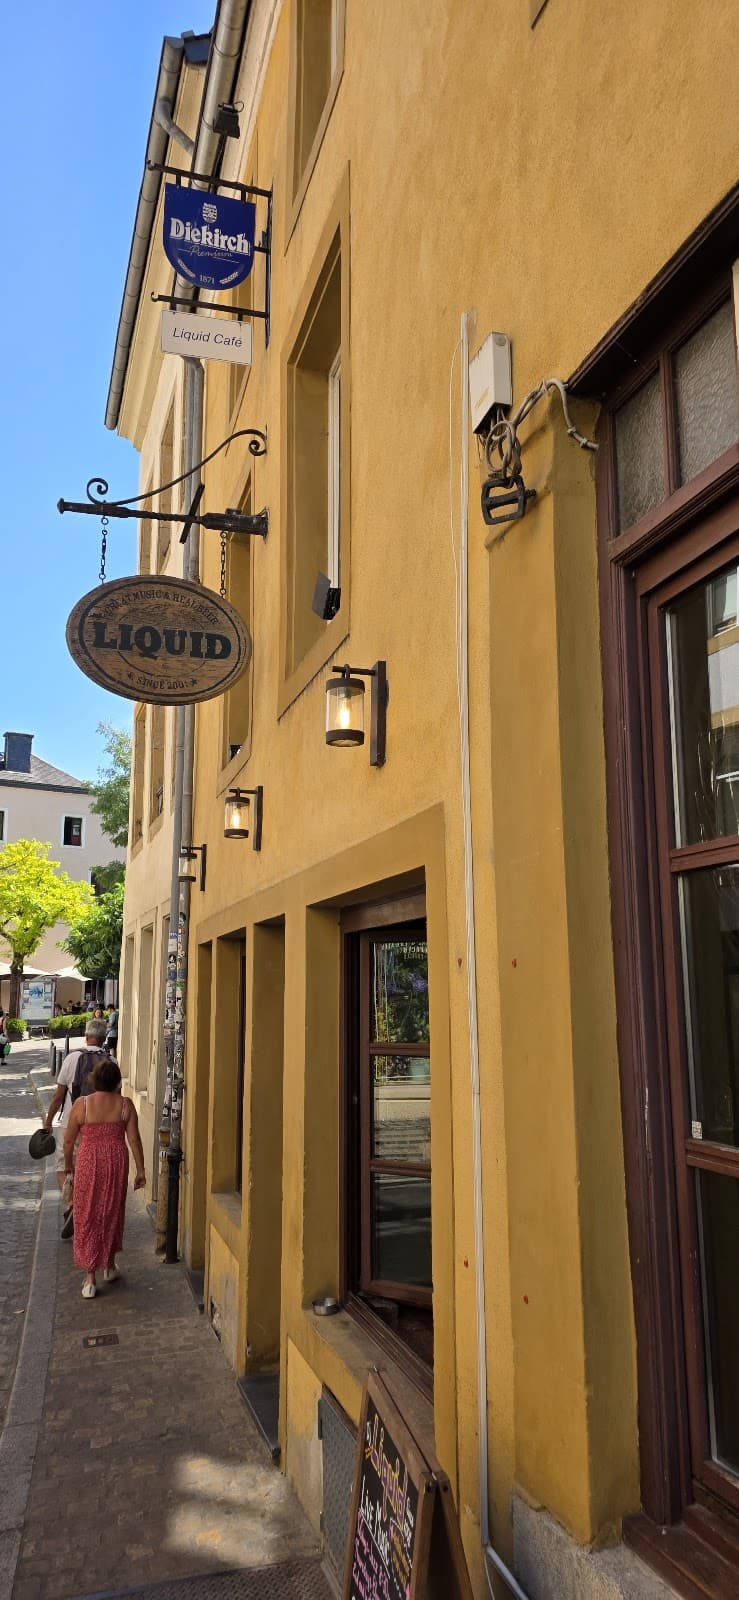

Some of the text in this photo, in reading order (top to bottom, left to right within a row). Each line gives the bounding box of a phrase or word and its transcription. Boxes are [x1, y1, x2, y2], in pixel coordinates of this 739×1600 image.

[170, 217, 250, 256] Diekirch
[200, 274, 215, 285] 1871
[172, 327, 243, 348] Liquid Café
[132, 589, 162, 601] MUSIC
[172, 593, 197, 608] REAL
[196, 604, 219, 625] BEER
[92, 621, 232, 660] LIQUID
[136, 677, 165, 690] SINCE
